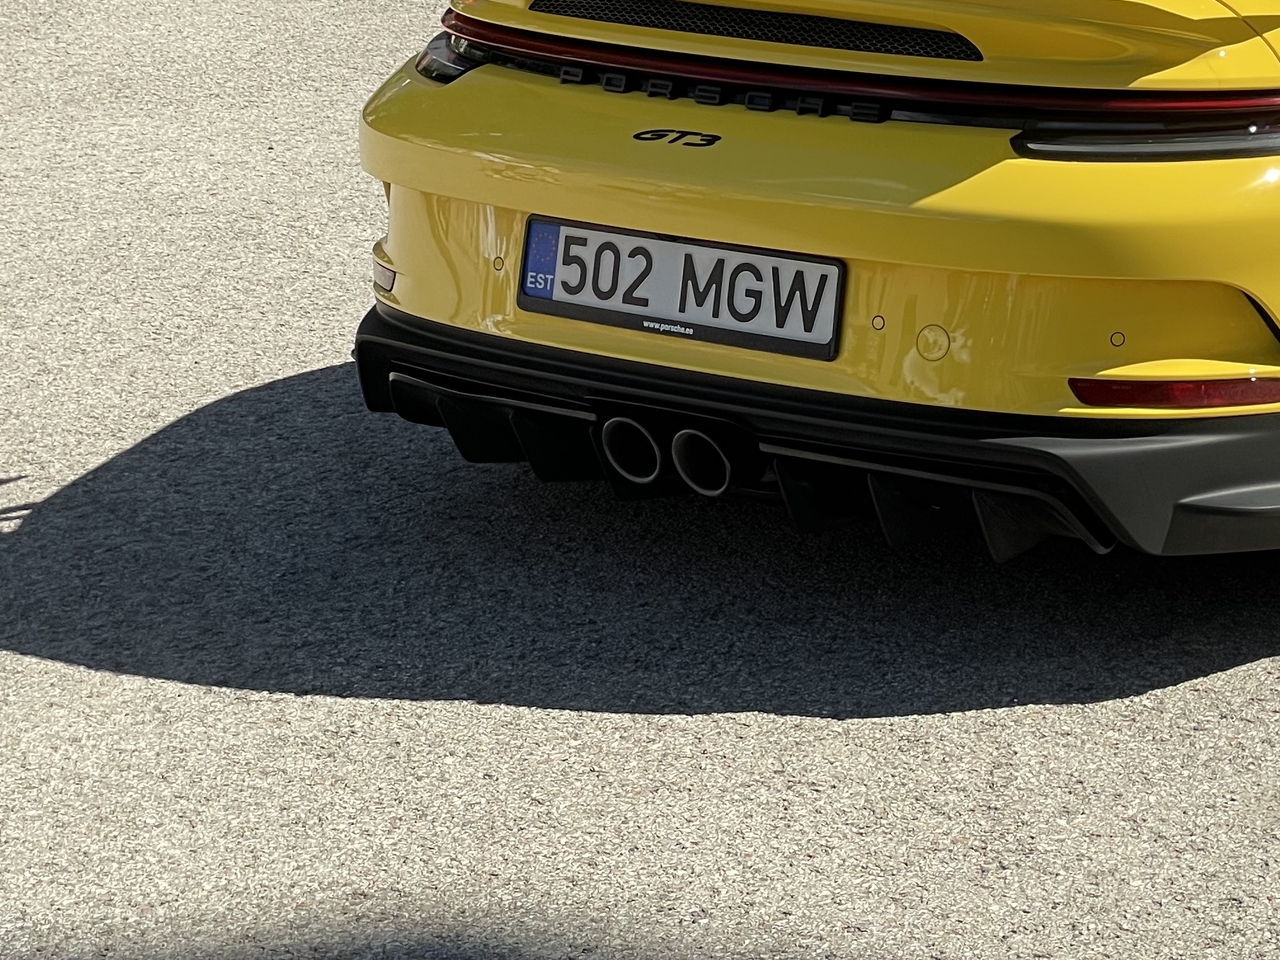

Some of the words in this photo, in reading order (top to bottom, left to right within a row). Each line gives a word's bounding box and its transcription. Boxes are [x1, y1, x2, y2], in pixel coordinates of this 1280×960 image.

[559, 66, 882, 123] PORSCHE
[632, 129, 722, 148] GT3
[526, 271, 554, 291] EST
[560, 234, 654, 308] 502
[678, 252, 829, 334] MGW
